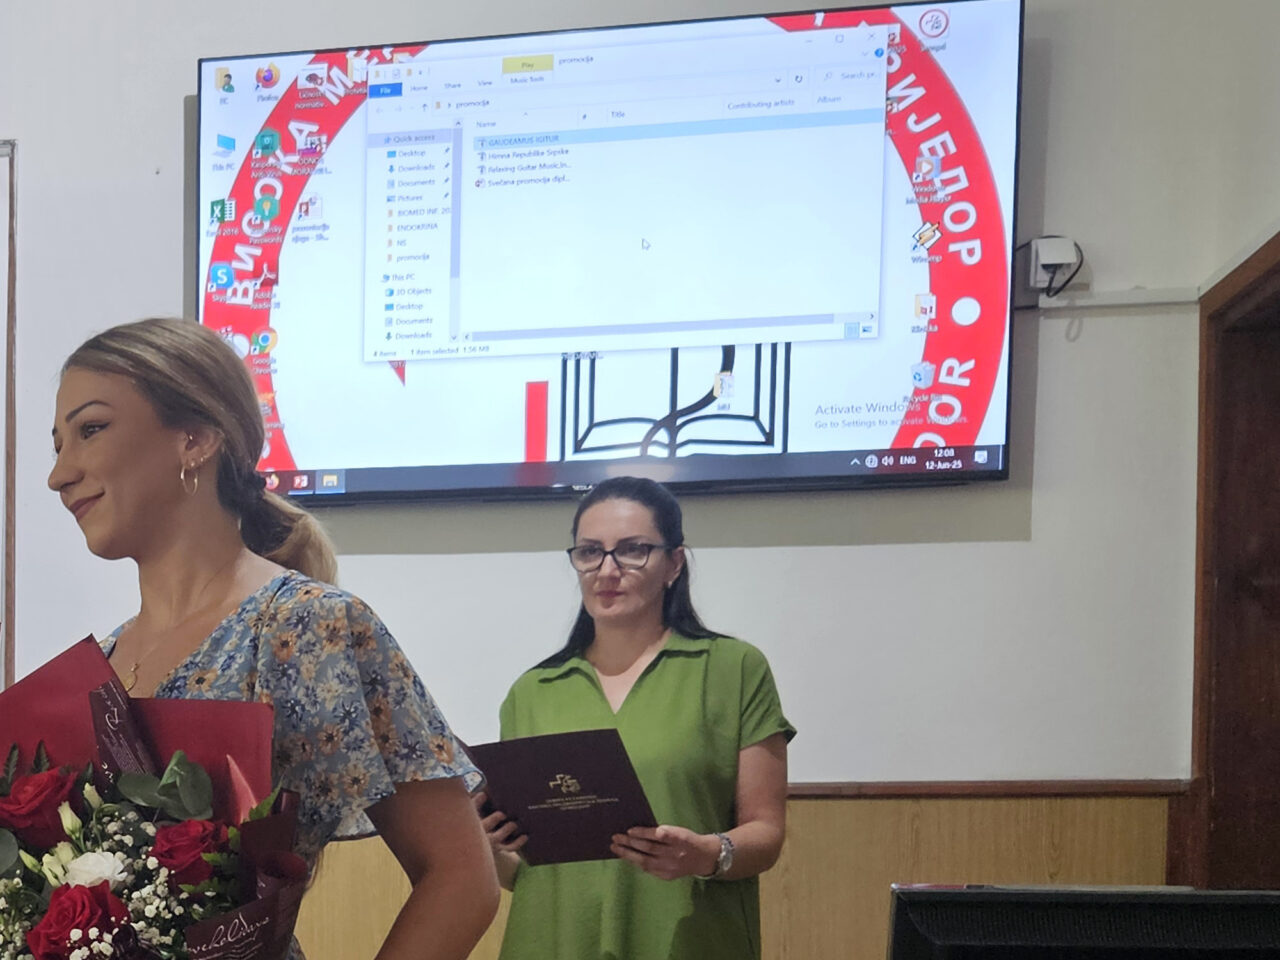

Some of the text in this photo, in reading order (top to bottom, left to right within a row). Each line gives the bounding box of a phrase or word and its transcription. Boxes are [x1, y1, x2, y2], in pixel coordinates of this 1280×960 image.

[476, 121, 496, 129] Name
[393, 135, 412, 143] Quick
[815, 401, 921, 415] Activate Windows
[814, 421, 827, 429] Go
[828, 420, 839, 429] to
[841, 418, 876, 429] Settings
[878, 418, 888, 427] to
[890, 416, 923, 426] activate
[900, 456, 916, 465] ENG
